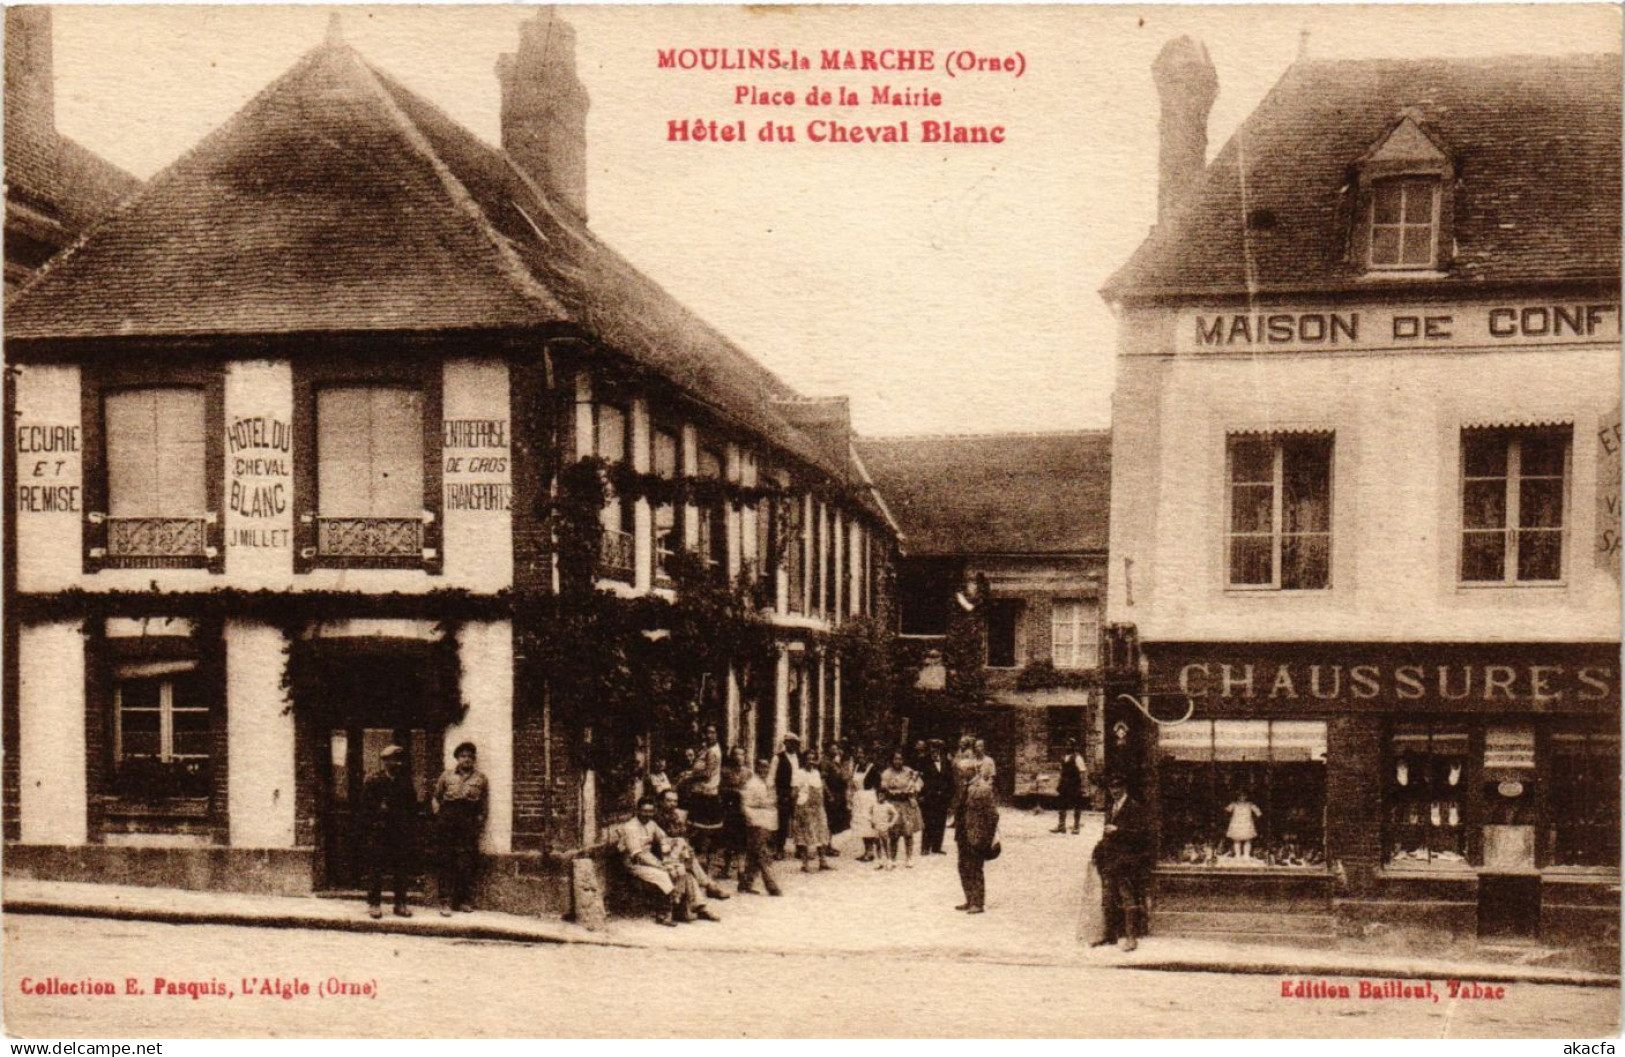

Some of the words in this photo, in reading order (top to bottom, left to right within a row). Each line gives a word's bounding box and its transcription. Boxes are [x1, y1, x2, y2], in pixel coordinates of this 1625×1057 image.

[1195, 312, 1359, 346] MAISON
[1393, 315, 1453, 339] DE
[18, 426, 79, 452] ECURIE
[272, 420, 290, 453] DU
[441, 420, 508, 448] ENTREPRISE
[236, 459, 289, 476] CHEVAL
[446, 457, 463, 473] DE
[20, 486, 79, 512] REMISE
[230, 479, 286, 518] BLANC
[446, 483, 514, 510] TRANSPORTS
[1179, 664, 1613, 700] CHAUSSURES
